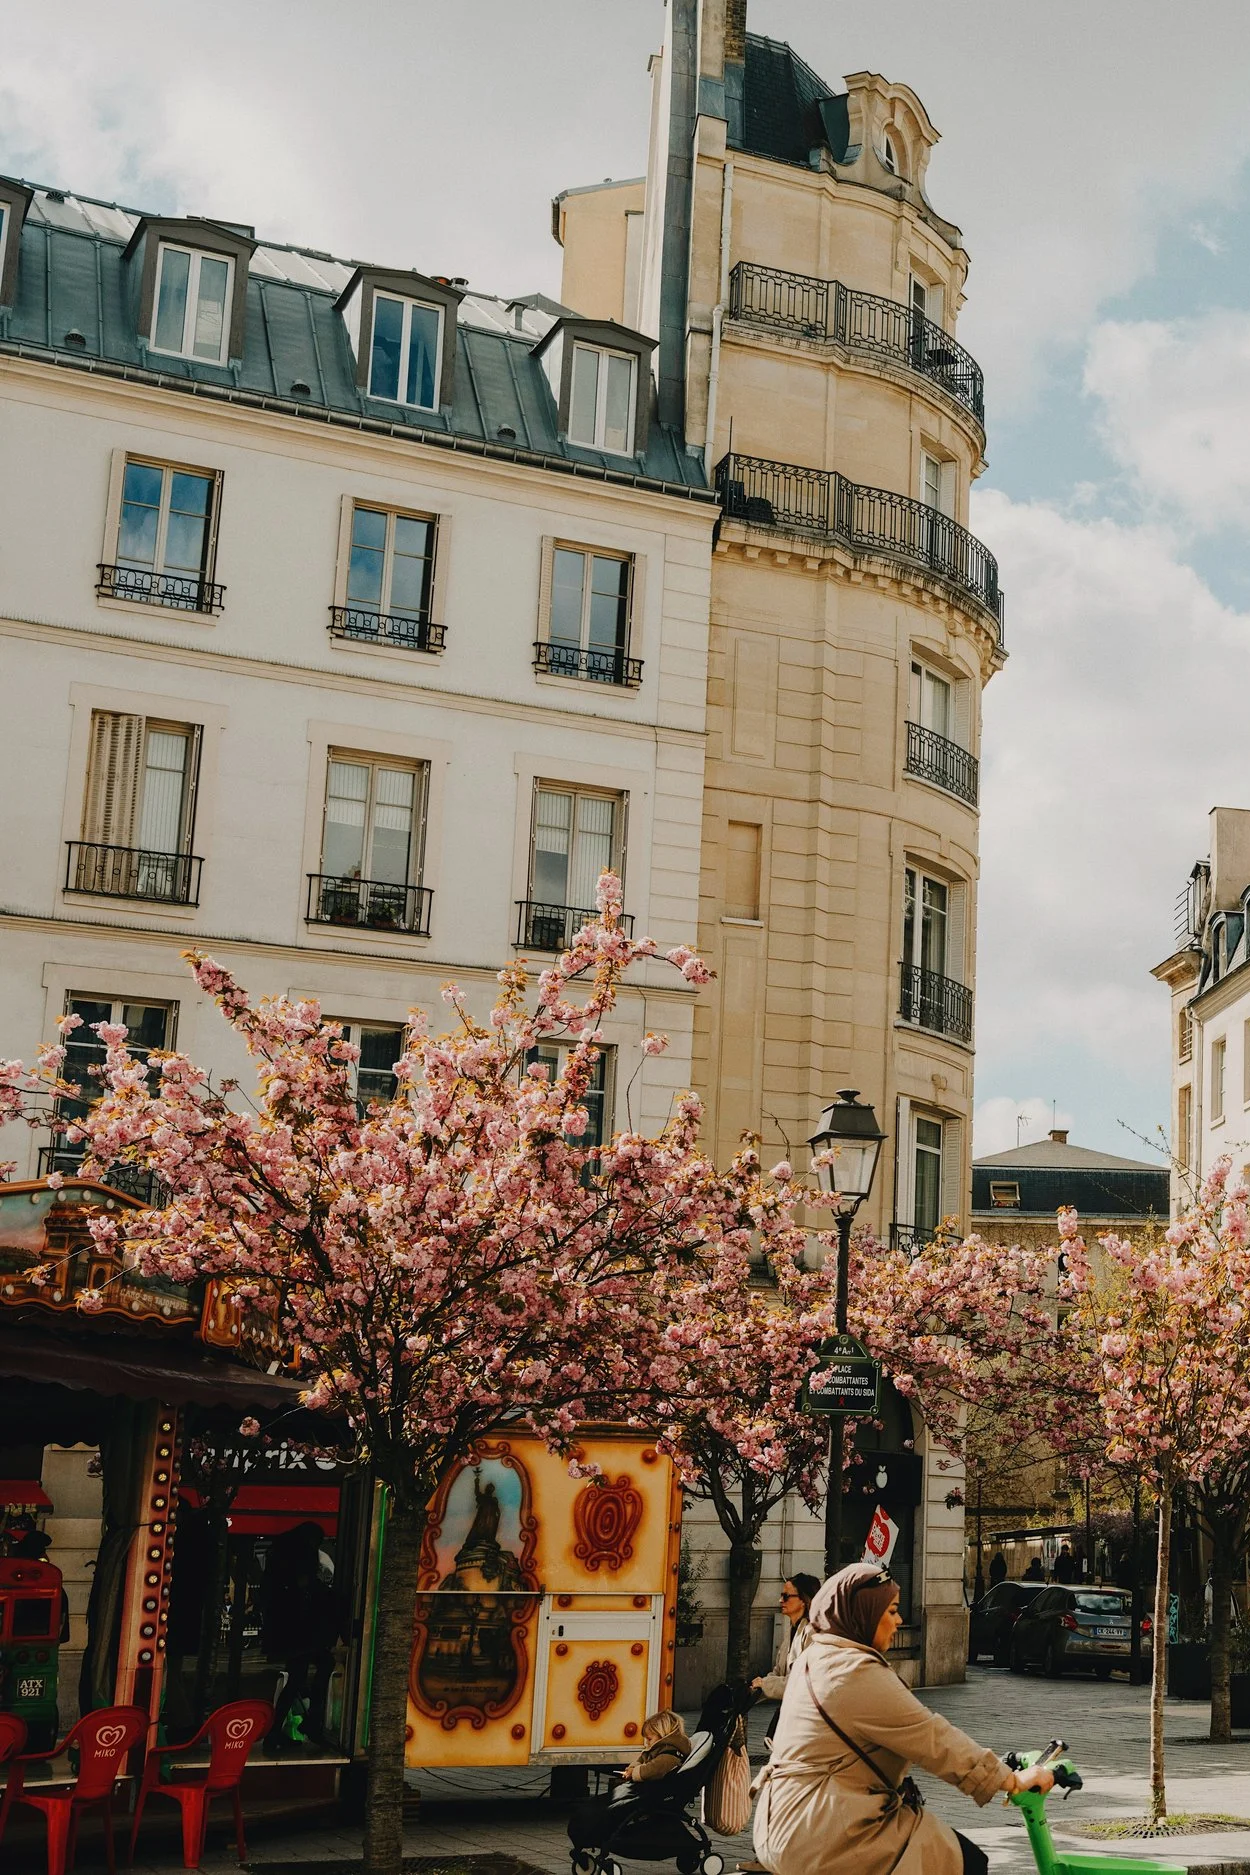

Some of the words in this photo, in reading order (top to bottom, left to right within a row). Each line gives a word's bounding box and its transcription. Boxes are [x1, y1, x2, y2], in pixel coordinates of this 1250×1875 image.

[855, 1388, 862, 1396] DU
[863, 1389, 875, 1397] SIDA
[19, 1679, 44, 1688] ATX
[21, 1687, 41, 1697] 921
[225, 1740, 245, 1749] MIKO
[94, 1749, 116, 1758] MIKO
